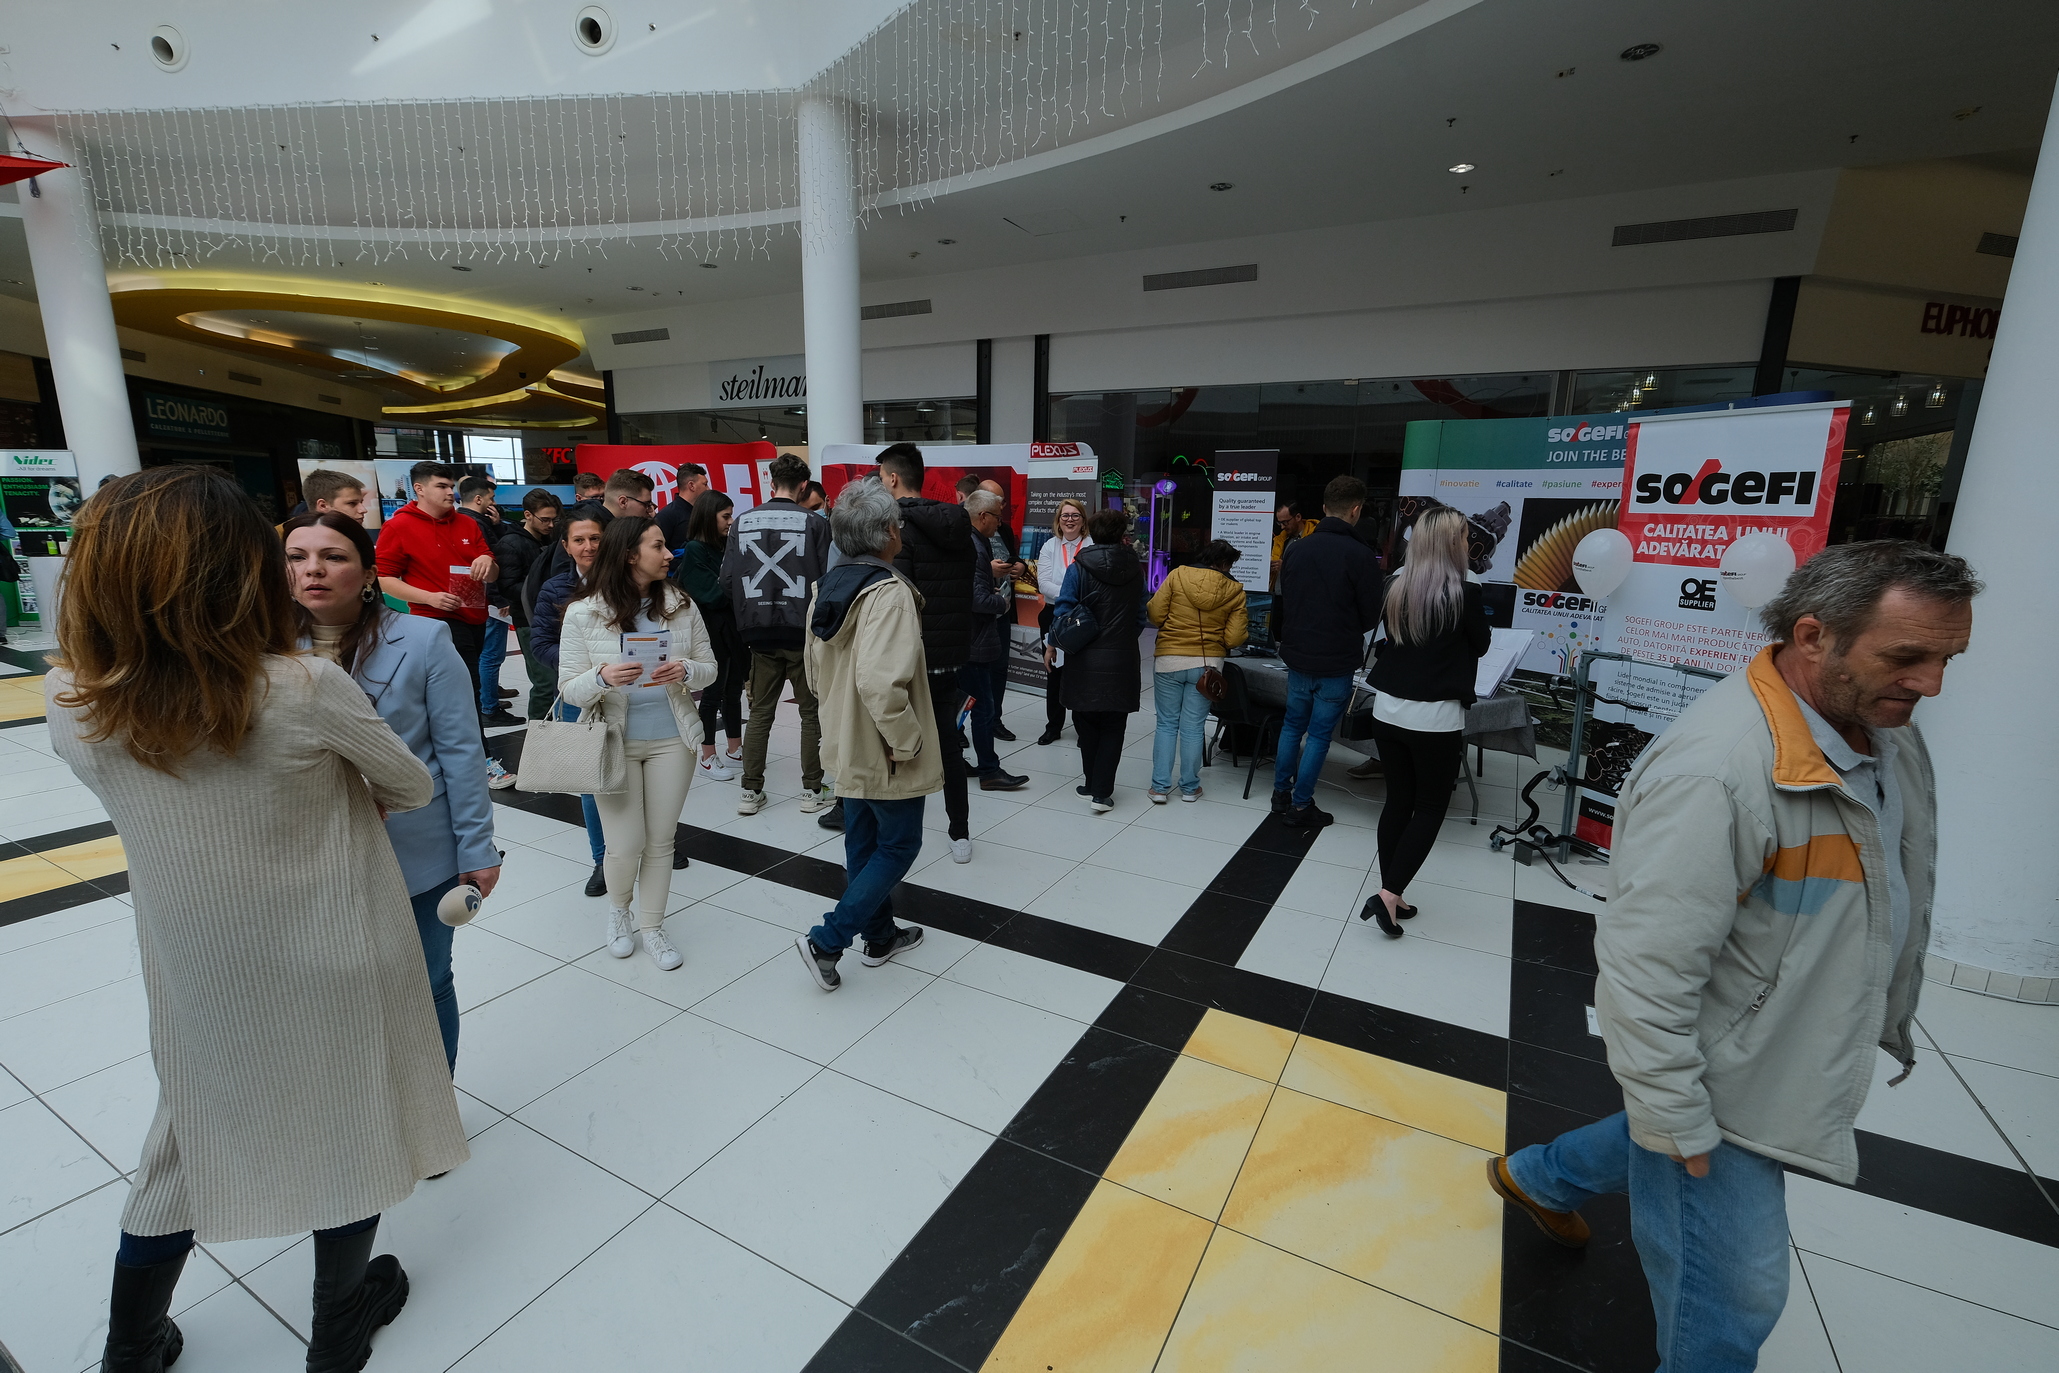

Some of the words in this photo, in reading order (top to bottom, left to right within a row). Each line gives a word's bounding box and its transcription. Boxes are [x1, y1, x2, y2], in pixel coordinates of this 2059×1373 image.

[146, 397, 228, 428] LEONARDO
[150, 422, 186, 434] CALZATURE
[297, 439, 341, 457] LEONARDO
[1031, 444, 1078, 457] PLEXUS
[1546, 450, 1579, 462] JOIN
[1582, 449, 1608, 462] THE
[13, 455, 58, 466] Nidec
[1496, 479, 1533, 488] #calitate
[1542, 480, 1582, 490] #pasiune
[1643, 523, 1729, 541] CALITATEA
[1680, 577, 1718, 600] OE
[1521, 607, 1552, 616] CALITATEA
[1679, 598, 1715, 609] SUPPLIER
[1624, 615, 1652, 626] SOGEFI
[1653, 619, 1685, 630] GROUP
[1686, 624, 1708, 634] ESTE
[1625, 626, 1650, 637] CELOR
[1651, 630, 1669, 640] MAI
[1670, 633, 1695, 644] MARI
[1617, 636, 1641, 648] AUTO,
[1643, 639, 1687, 655] DATORITĂ
[1620, 646, 1631, 655] DE
[1632, 648, 1655, 660] PESTE
[1657, 653, 1667, 662] 35
[1669, 655, 1681, 664] DE
[1683, 657, 1701, 668] ANI
[1617, 671, 1632, 679] Lider
[1632, 675, 1659, 685] mondial
[1614, 679, 1635, 688] sisteme
[1645, 687, 1671, 697] admisie
[1626, 690, 1646, 700] Sogefi
